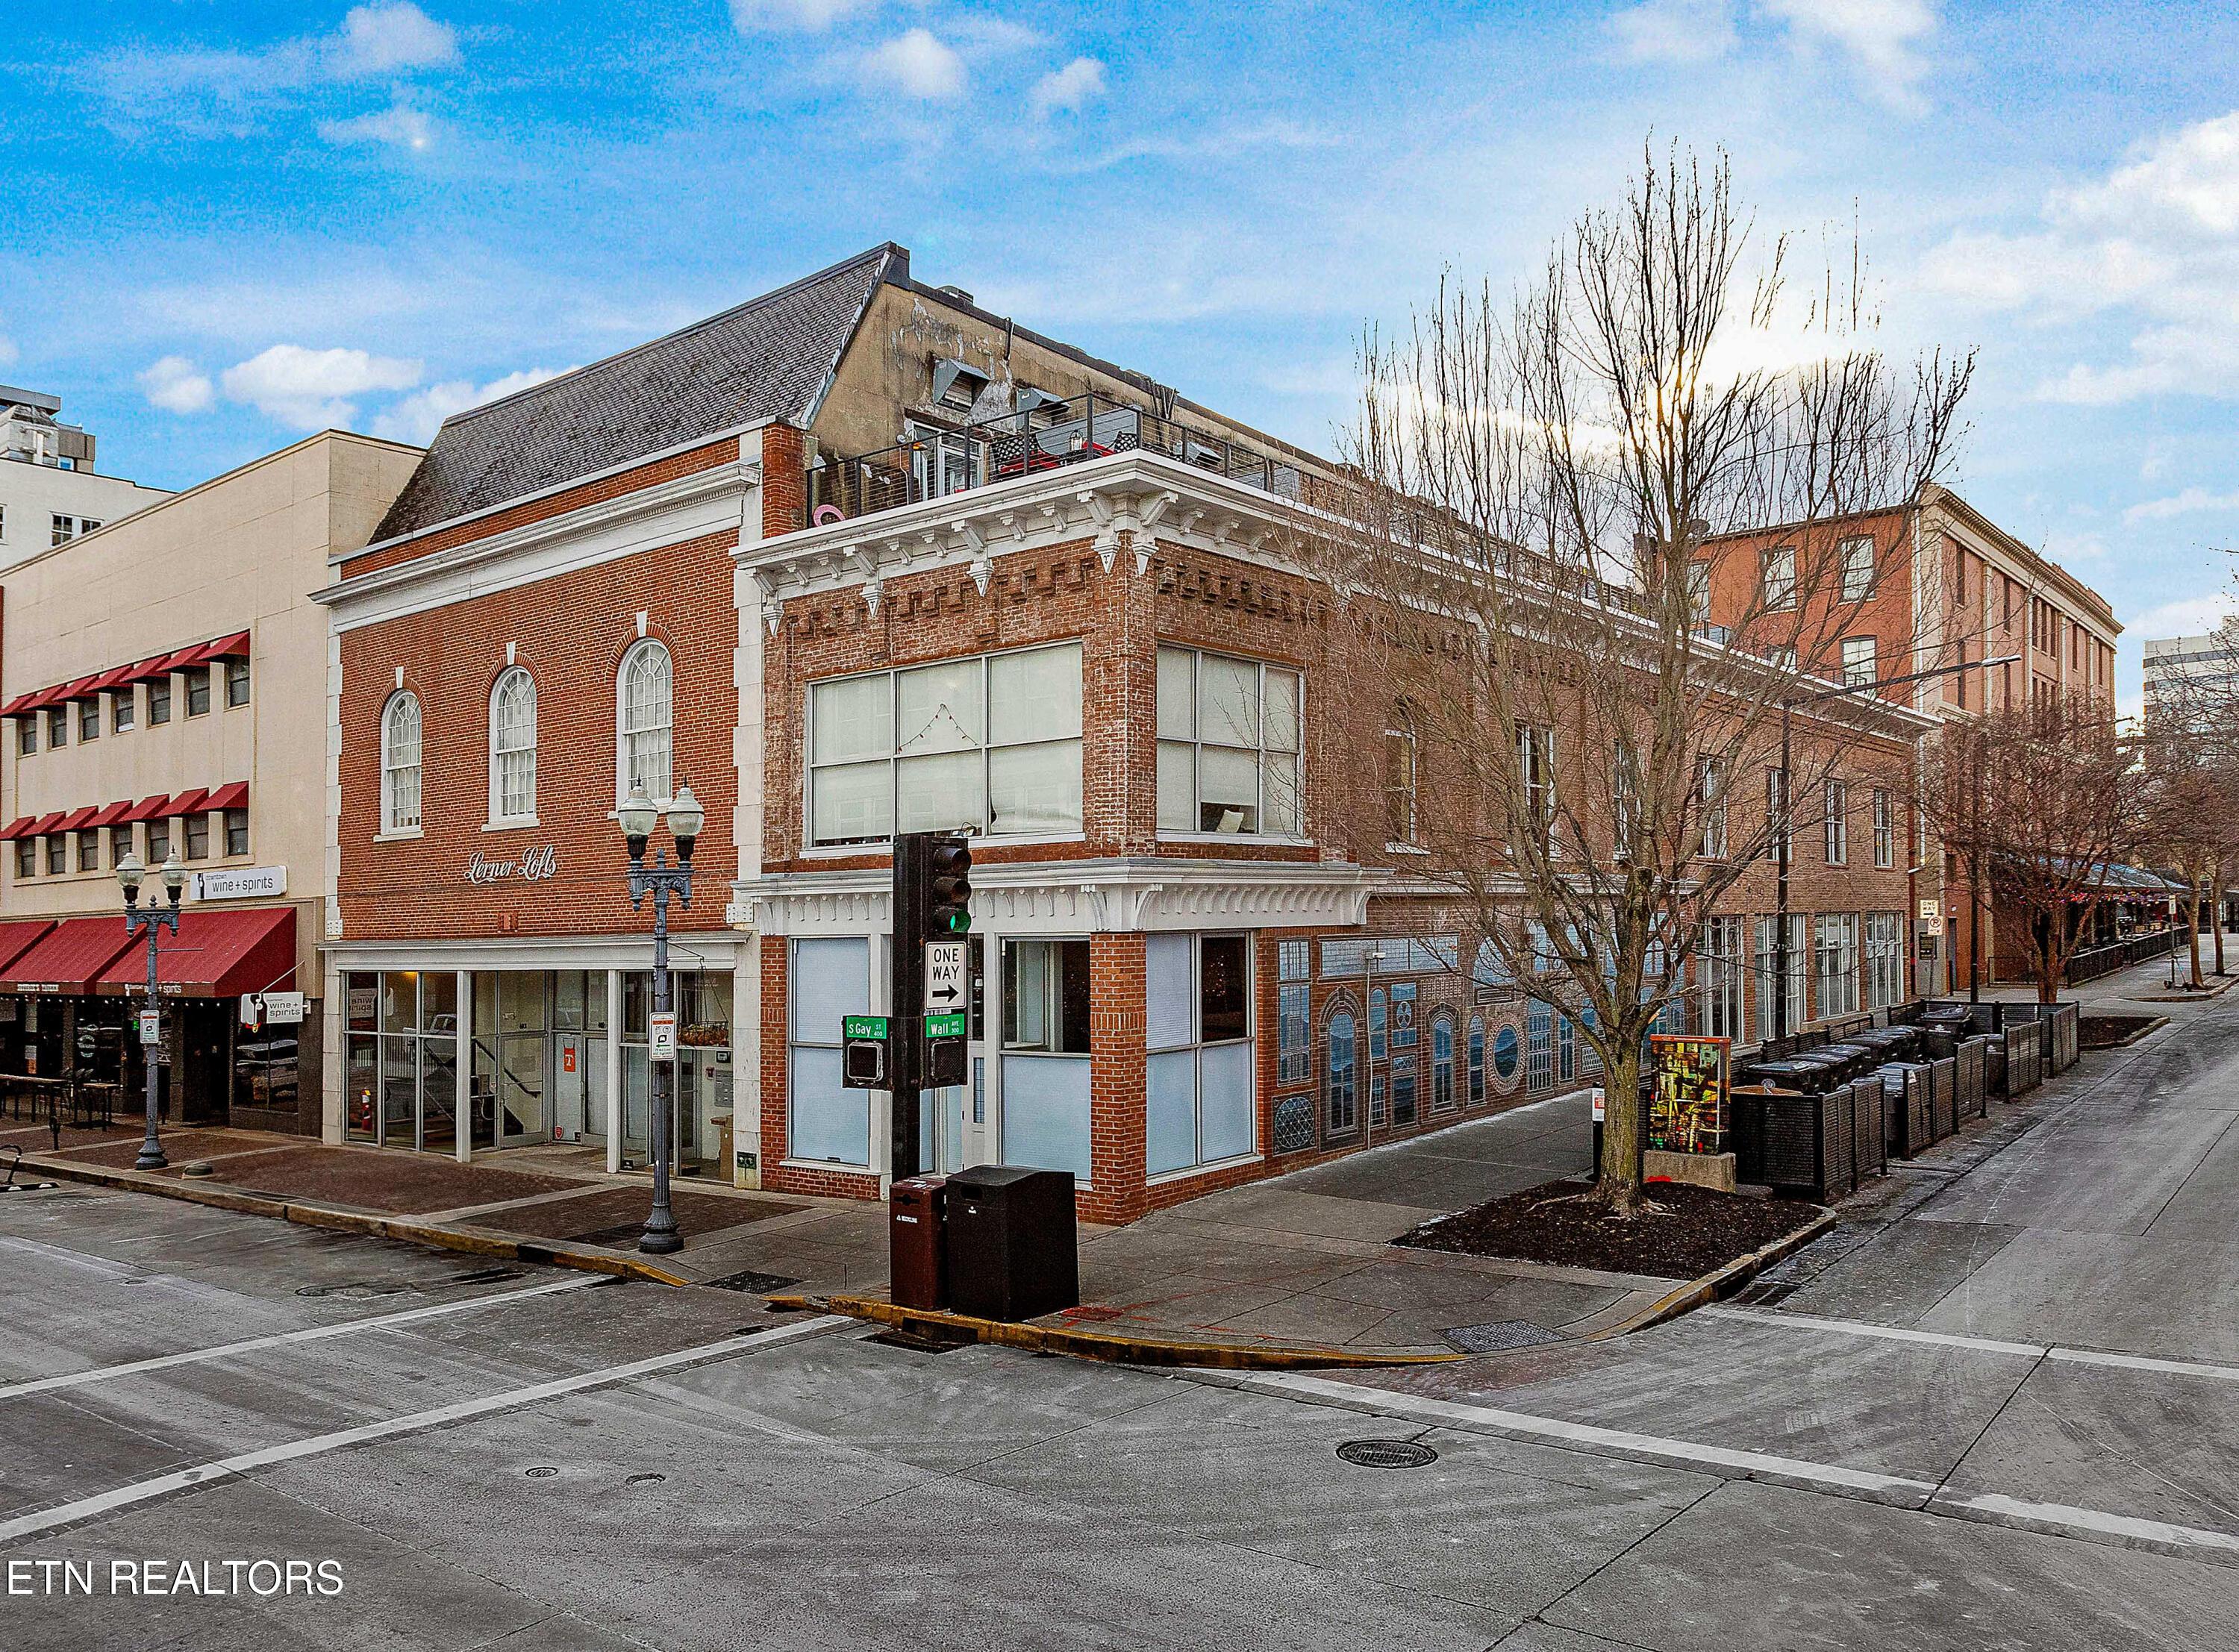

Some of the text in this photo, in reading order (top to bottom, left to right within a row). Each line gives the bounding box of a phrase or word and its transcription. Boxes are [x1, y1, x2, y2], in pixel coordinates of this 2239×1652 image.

[463, 844, 557, 884] Lerner Lofts
[212, 880, 234, 892] wine
[242, 876, 273, 893] spirits
[934, 948, 959, 963] ONE
[932, 966, 960, 980] WAY
[269, 1009, 301, 1017] spirits
[849, 1024, 854, 1034] S
[855, 1023, 872, 1038] Gay
[931, 1023, 949, 1035] Wall
